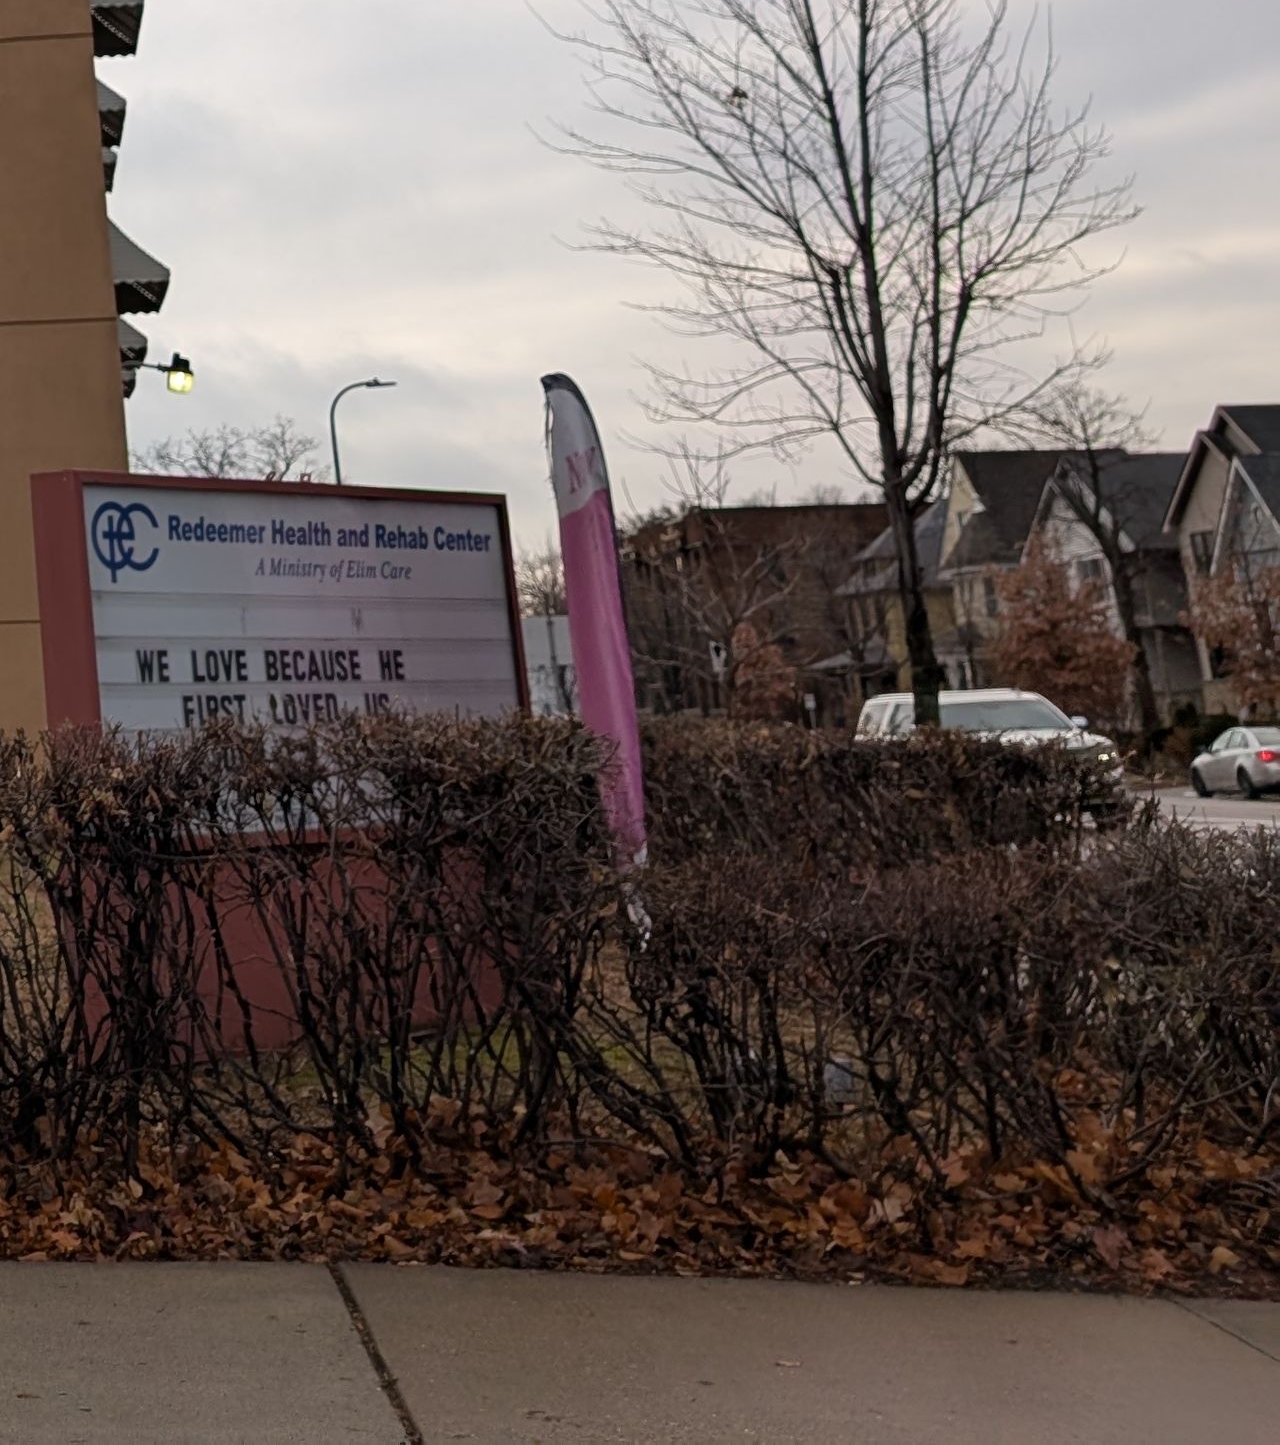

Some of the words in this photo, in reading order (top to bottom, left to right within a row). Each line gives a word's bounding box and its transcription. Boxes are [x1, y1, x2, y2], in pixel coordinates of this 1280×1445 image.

[168, 515, 266, 544] Redeemer
[271, 519, 331, 546] Health
[337, 523, 369, 548] and
[375, 524, 428, 550] Rehab
[433, 526, 491, 552] Center
[255, 557, 266, 576] A
[269, 557, 327, 583] Ministry
[330, 559, 345, 583] of
[346, 560, 376, 579] Elim
[381, 561, 412, 580] Care
[135, 650, 170, 683] WE
[191, 650, 248, 682] LOVE
[263, 650, 361, 682] BECAUSE
[378, 650, 405, 681] HE
